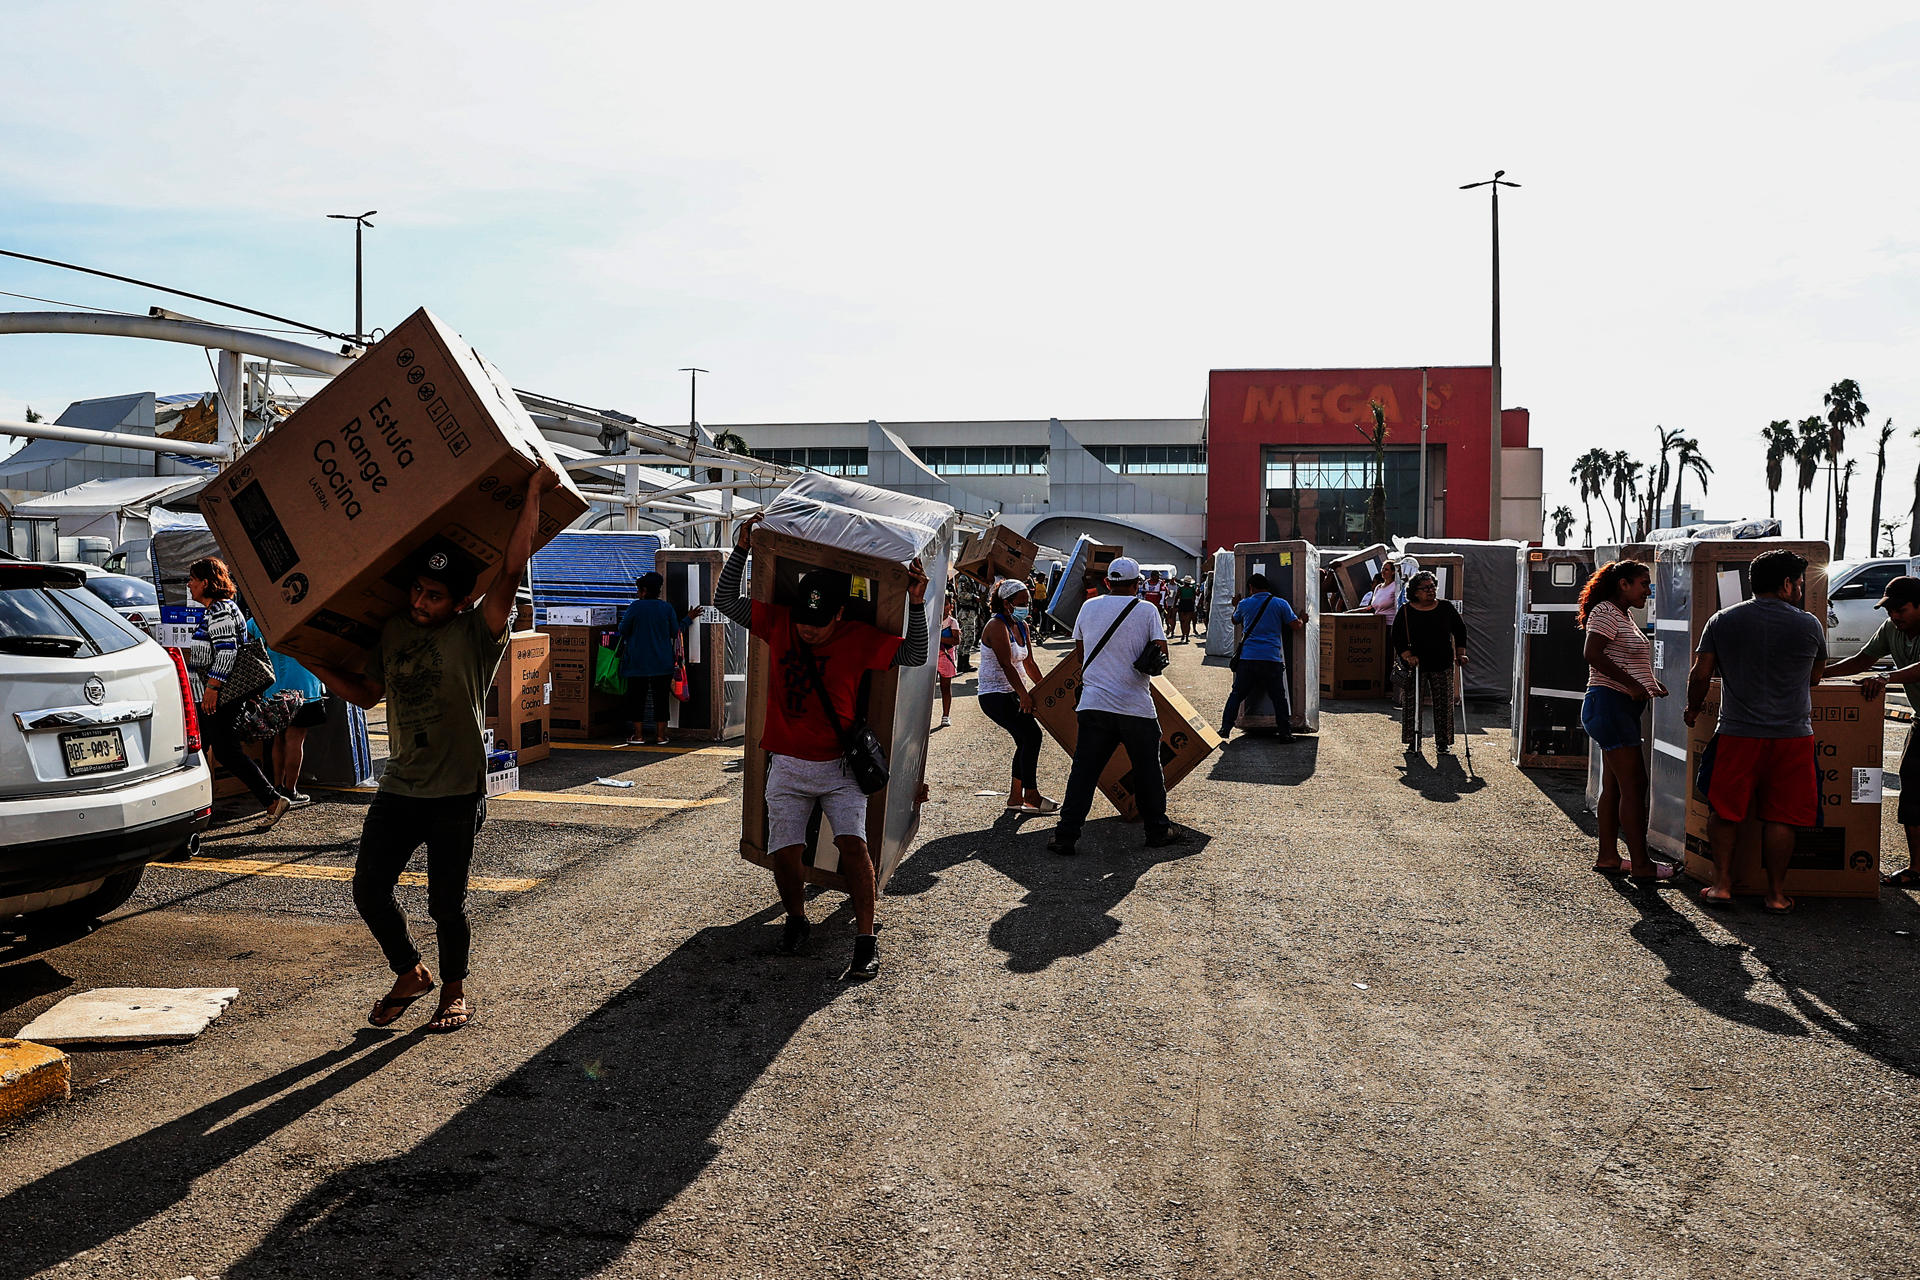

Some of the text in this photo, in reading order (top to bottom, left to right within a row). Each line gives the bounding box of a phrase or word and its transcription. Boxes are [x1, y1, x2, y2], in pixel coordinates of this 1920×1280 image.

[369, 396, 414, 469] Estufa
[1242, 383, 1403, 425] MEGA
[313, 439, 362, 520] Cocina
[340, 416, 387, 493] Range
[308, 476, 330, 511] LATERAL
